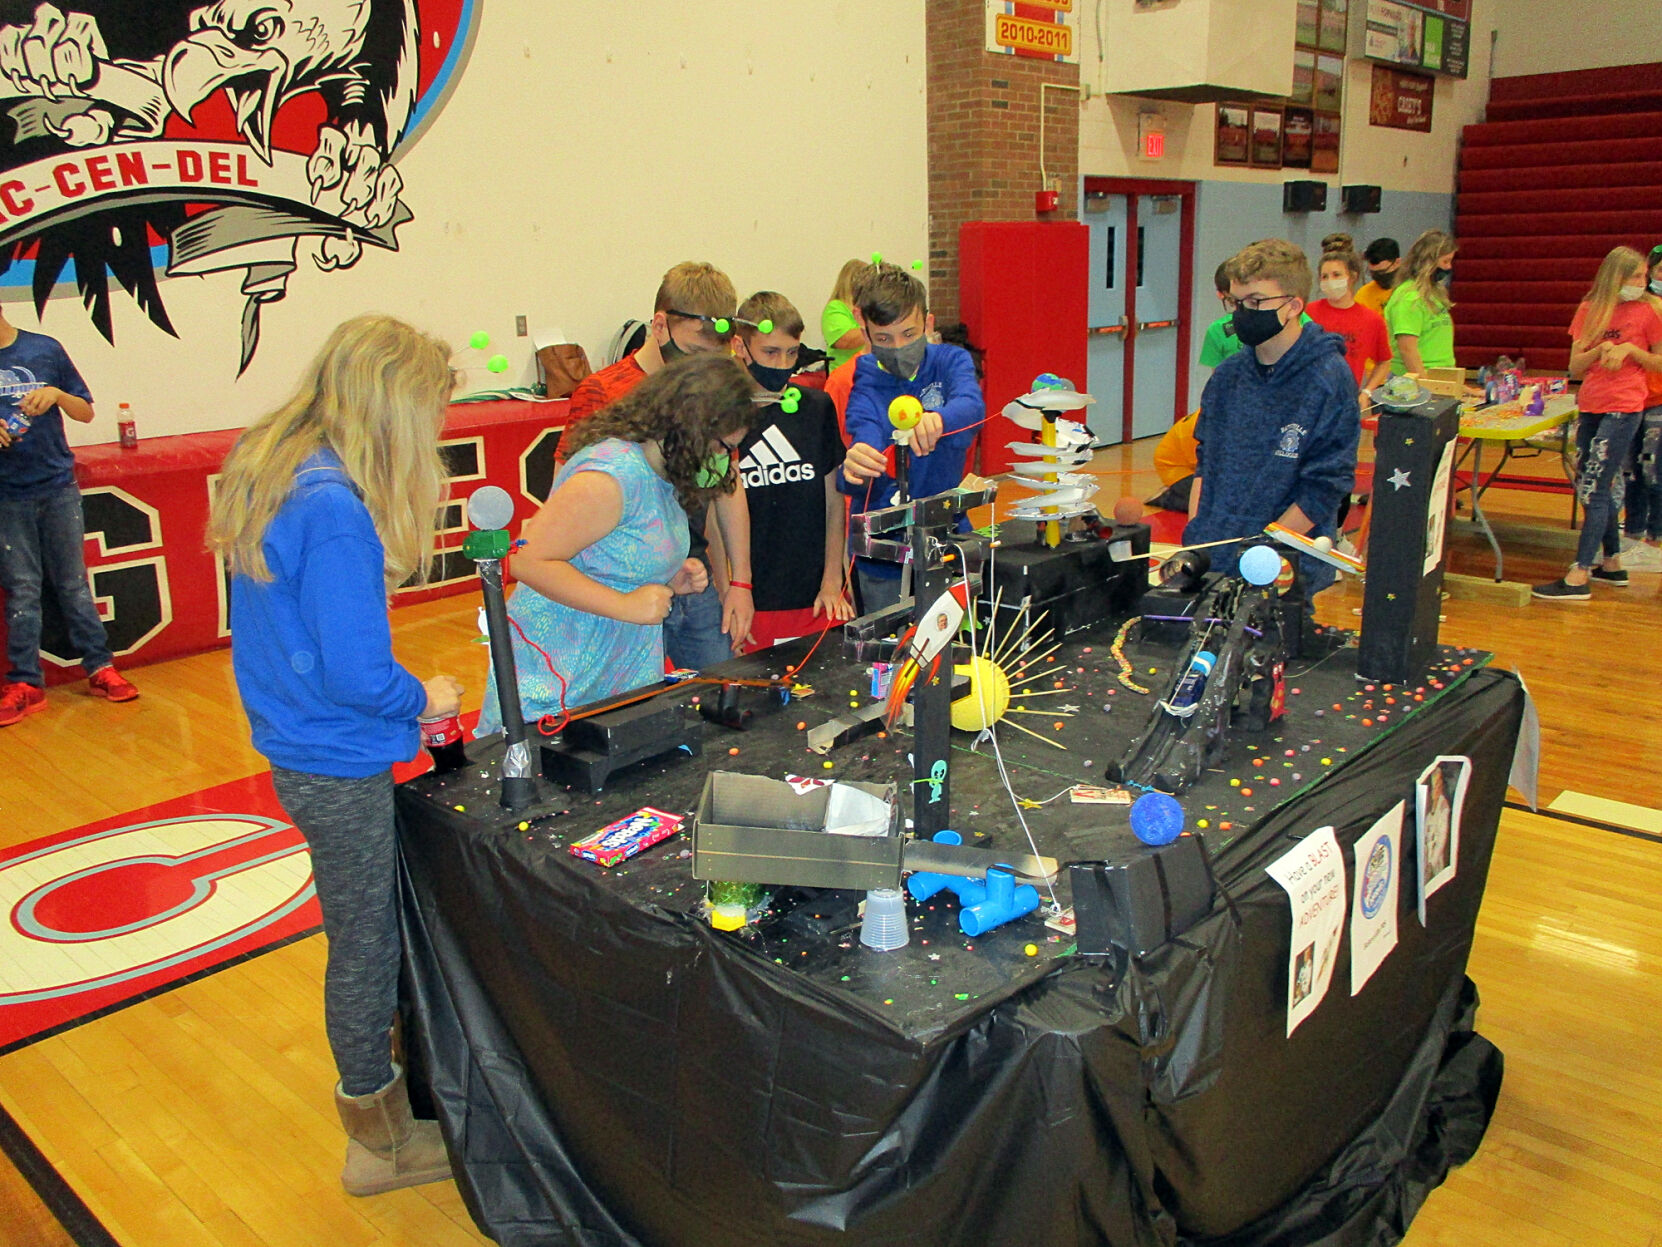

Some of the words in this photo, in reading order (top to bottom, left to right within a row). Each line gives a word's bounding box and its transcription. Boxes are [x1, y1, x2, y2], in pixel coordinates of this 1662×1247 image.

[1000, 22, 1068, 49] 2010-2011
[1147, 135, 1164, 156] EXIT
[1287, 865, 1307, 884] Have
[1308, 841, 1333, 867] BLAST
